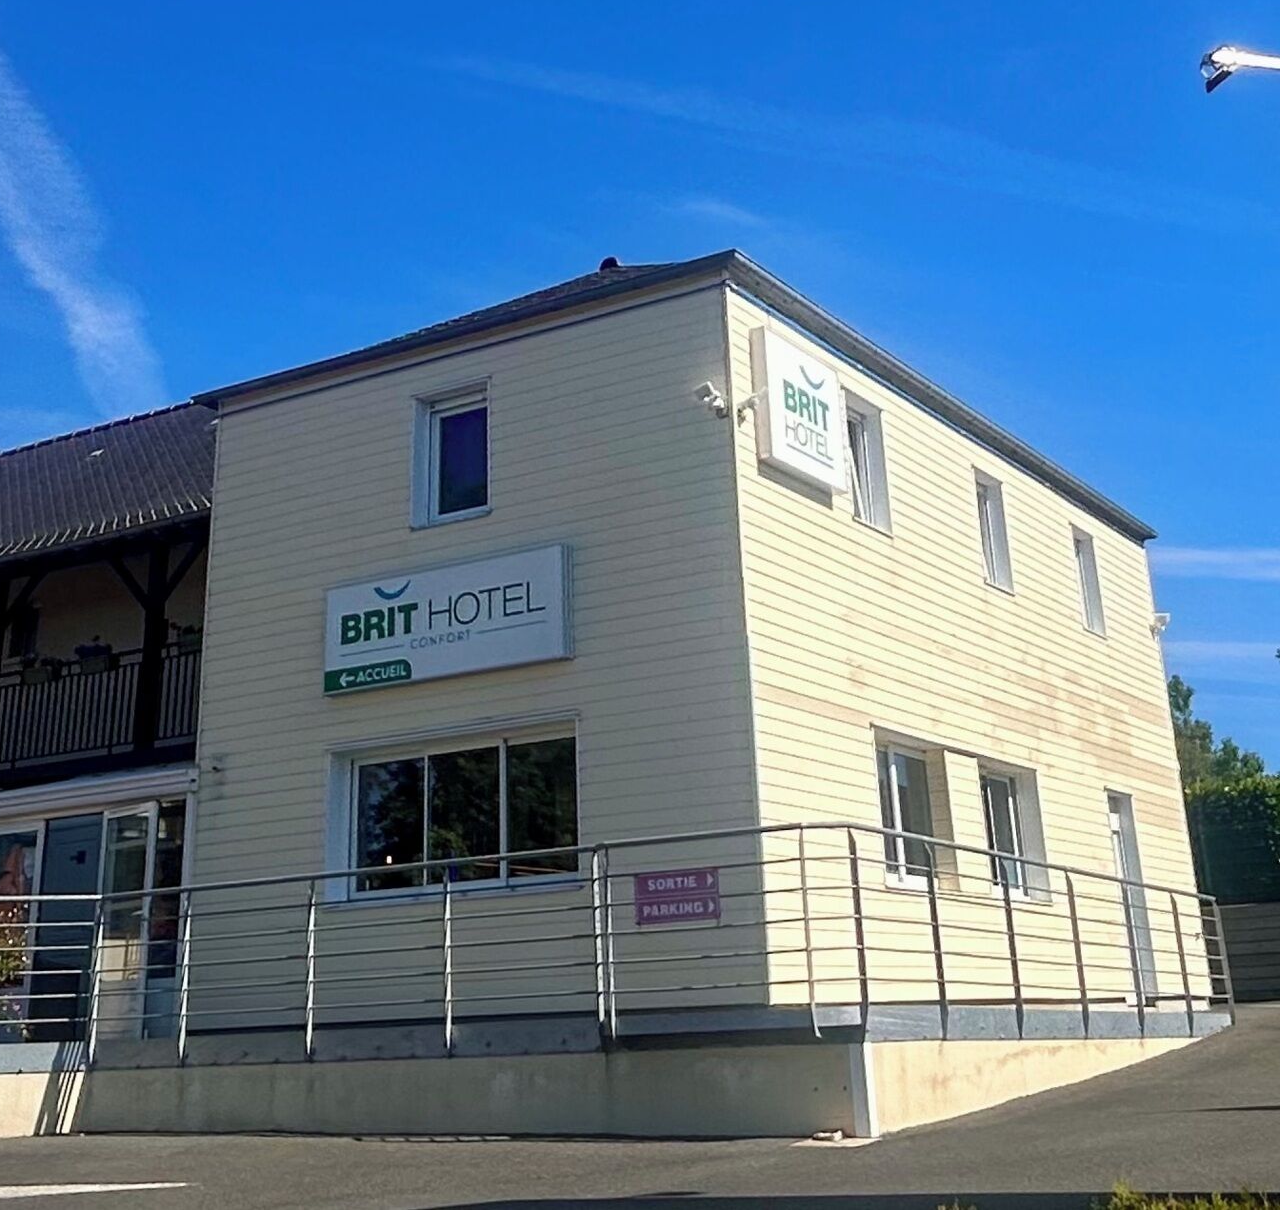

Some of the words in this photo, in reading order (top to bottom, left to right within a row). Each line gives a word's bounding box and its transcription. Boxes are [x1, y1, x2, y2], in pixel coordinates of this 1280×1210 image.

[783, 378, 830, 432] BRIT
[784, 415, 835, 462] HOTEL
[341, 602, 419, 645] BRIT
[428, 581, 547, 631] HOTEL
[410, 629, 472, 650] CONFORT
[355, 664, 407, 683] ACCUEIL
[648, 876, 697, 891] SORTIE
[643, 901, 704, 917] PARKING
